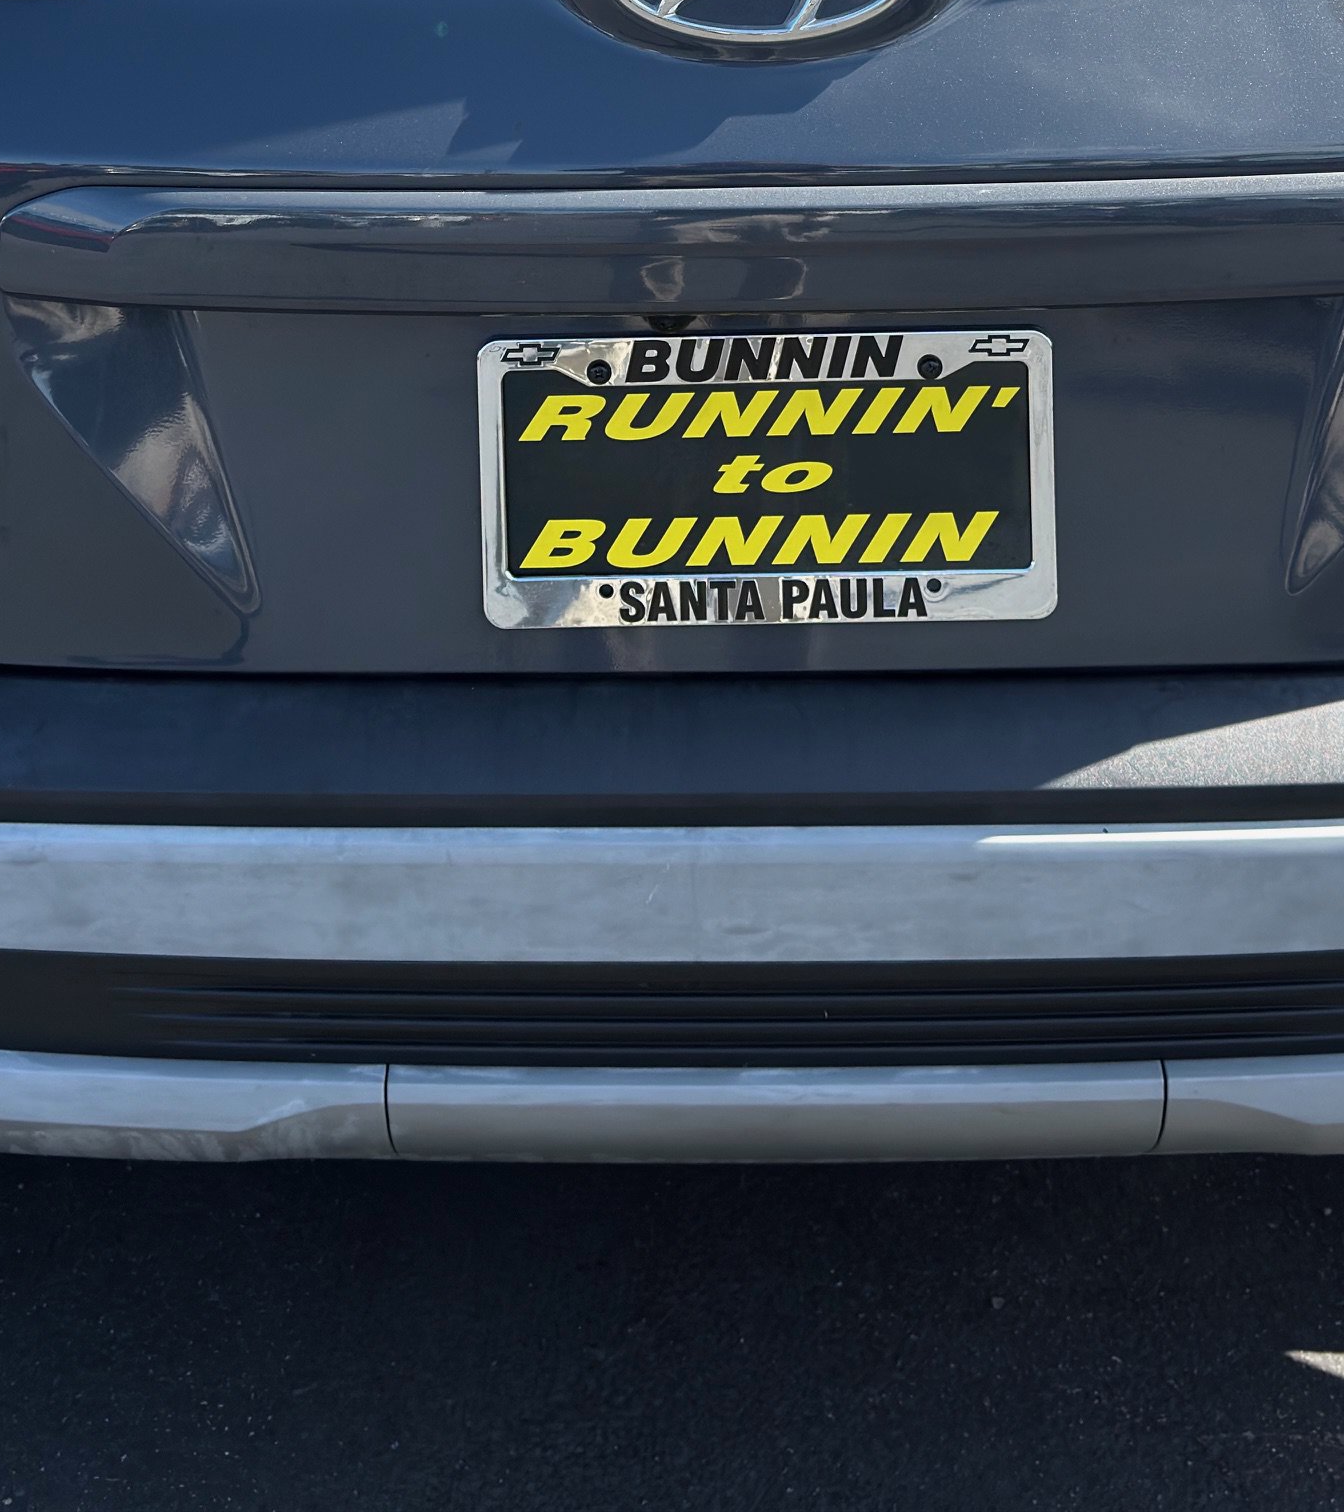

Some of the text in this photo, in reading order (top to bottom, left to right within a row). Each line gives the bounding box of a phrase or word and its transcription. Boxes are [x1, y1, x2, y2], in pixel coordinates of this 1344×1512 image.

[625, 335, 904, 382] BUNNIN
[518, 386, 1021, 442] RUNNIN'
[713, 455, 834, 494] to
[519, 511, 1000, 569] BUNNIN
[619, 577, 928, 623] SANTA PAULA
